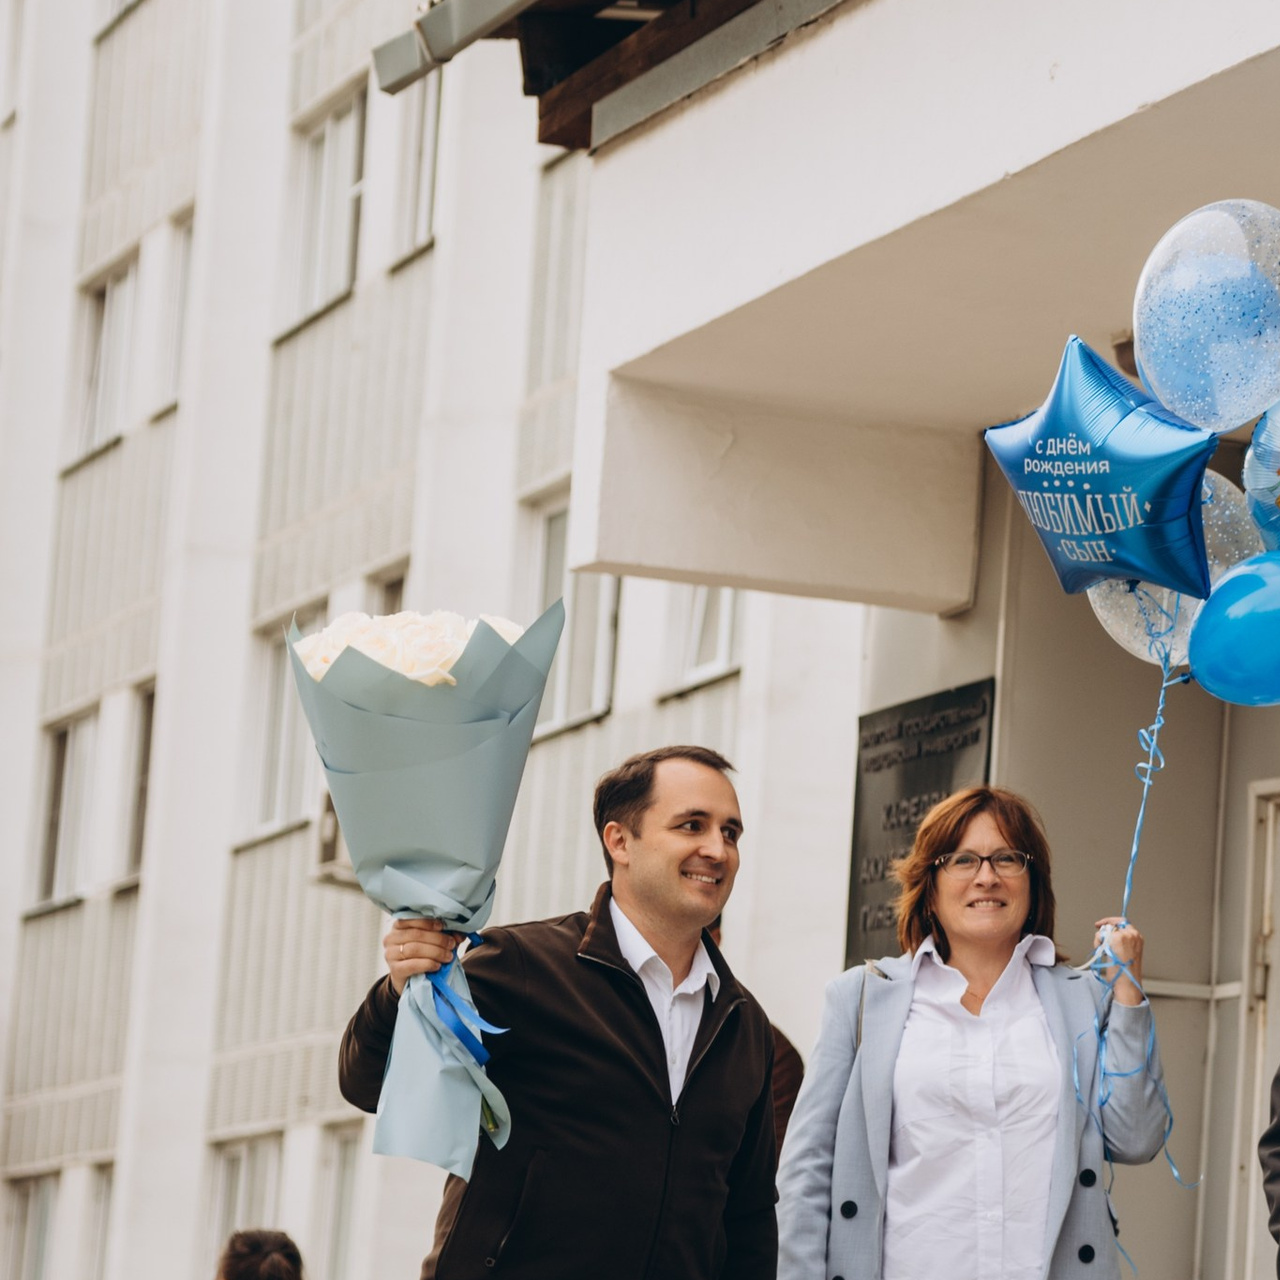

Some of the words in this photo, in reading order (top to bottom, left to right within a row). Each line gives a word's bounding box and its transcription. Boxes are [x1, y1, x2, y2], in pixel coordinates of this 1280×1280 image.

[1024, 458, 1110, 477] рождения
[1018, 486, 1145, 536] ЛЮБИМЫЙ
[1064, 539, 1114, 563] СЫН
